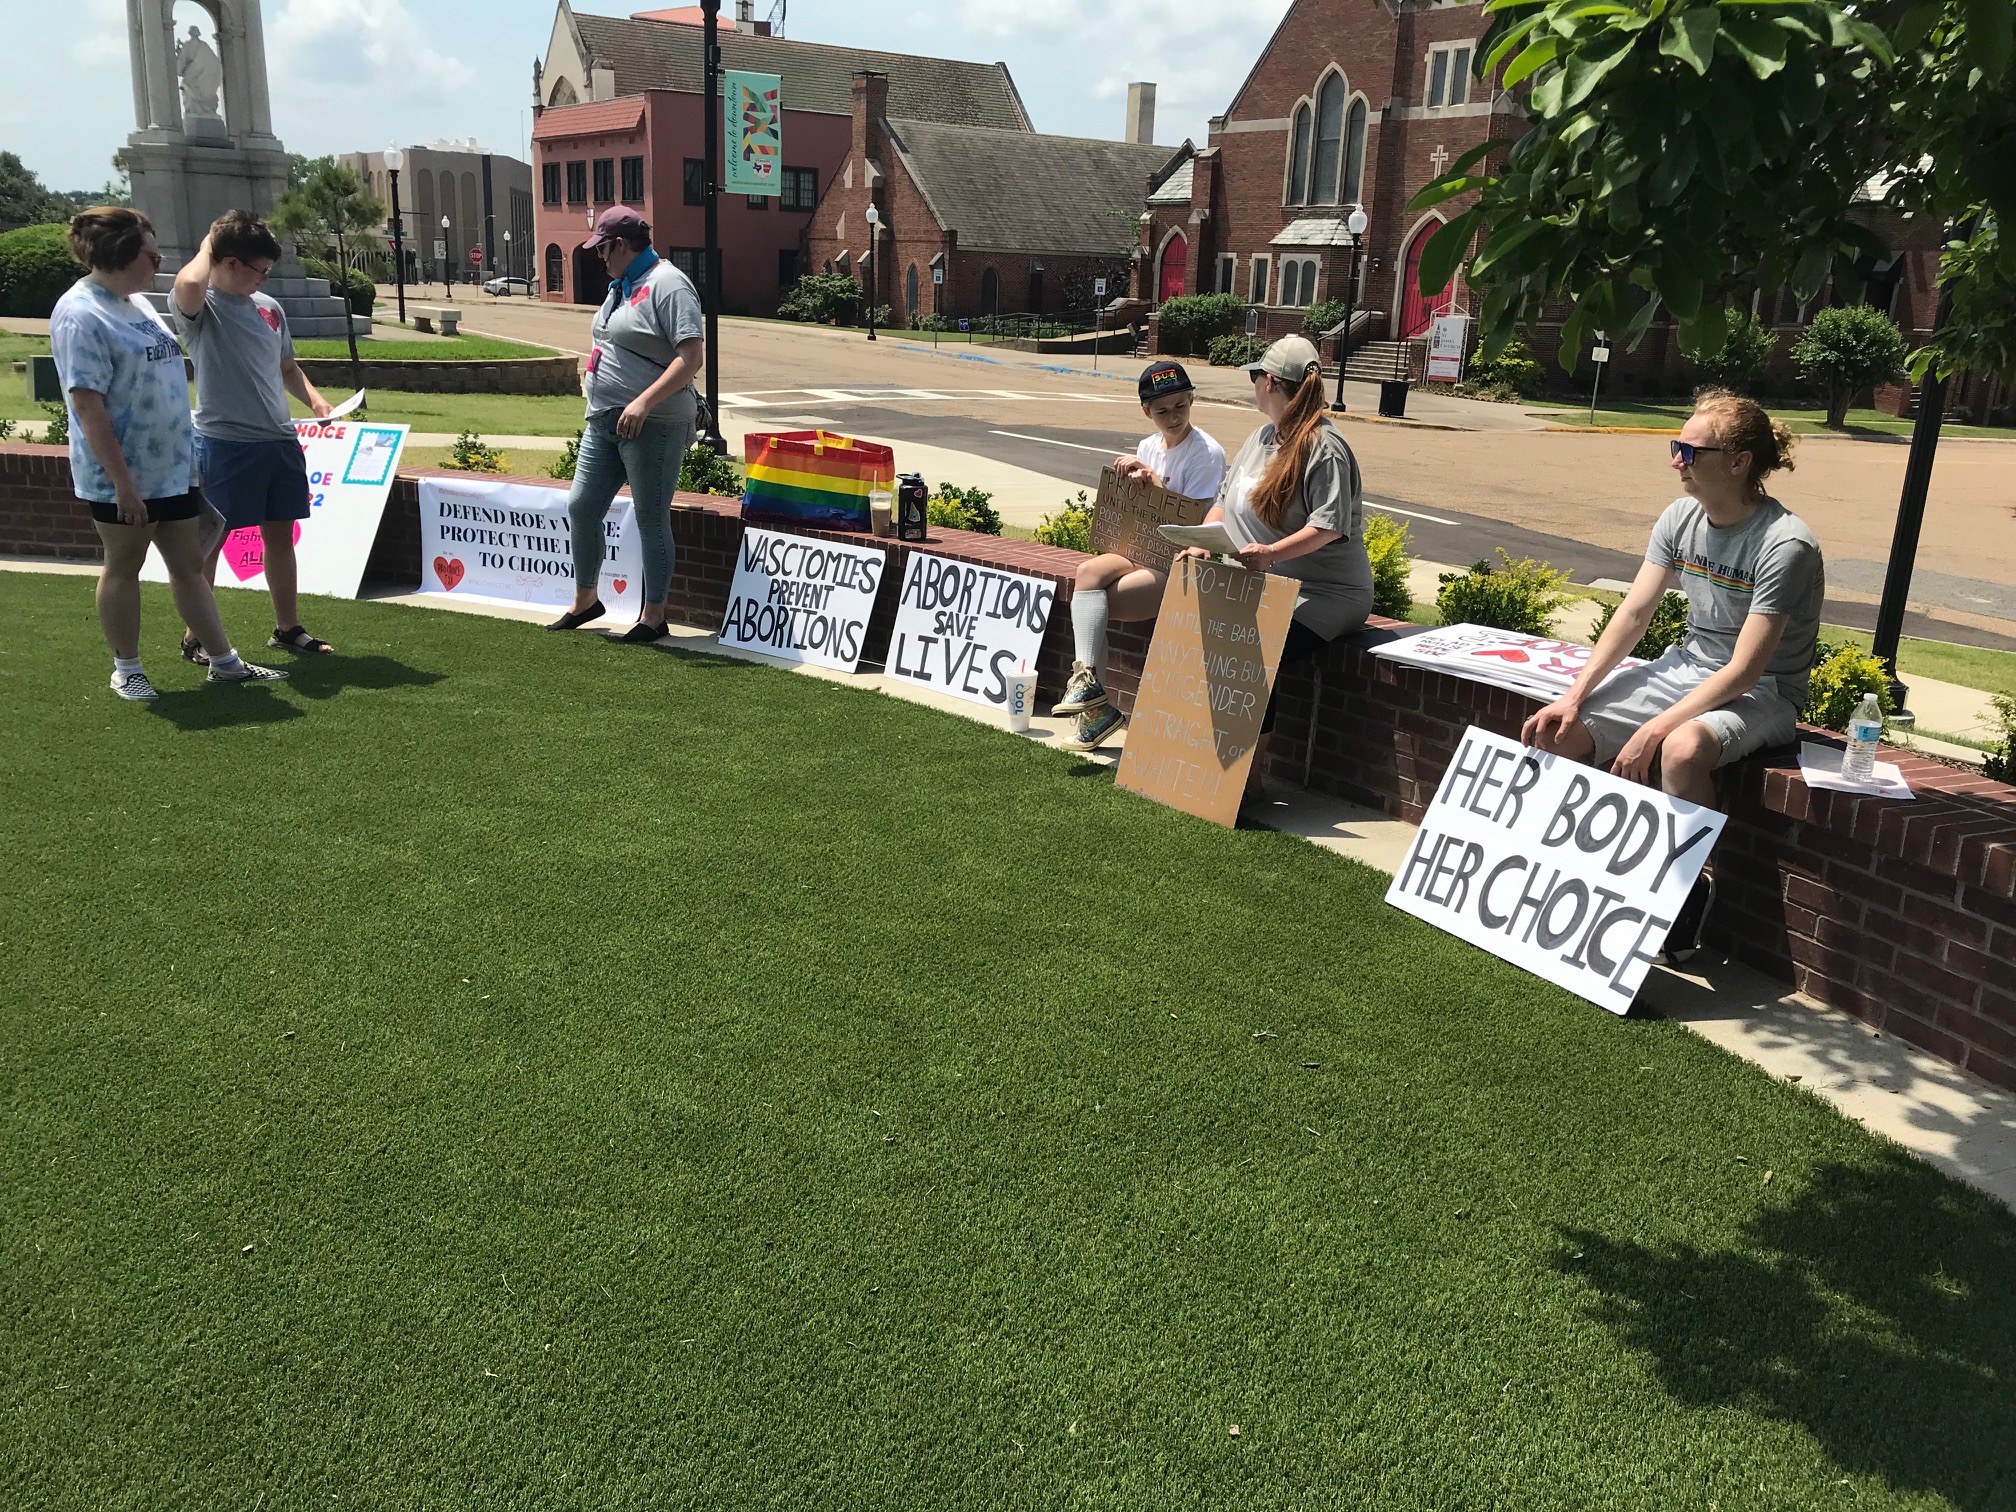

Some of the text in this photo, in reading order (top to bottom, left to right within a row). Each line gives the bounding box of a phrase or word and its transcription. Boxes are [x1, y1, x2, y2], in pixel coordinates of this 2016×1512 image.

[727, 82, 738, 178] welcome to downtown
[296, 424, 347, 440] HOICE
[439, 501, 506, 525] DEFEND
[509, 510, 546, 530] ROE
[549, 519, 558, 531] v
[1103, 493, 1129, 513] UNTIL
[1132, 504, 1148, 519] THE
[439, 524, 520, 549] PROTECT
[523, 535, 561, 554] THE
[1093, 536, 1172, 570] OR AN IMMIGRAN
[479, 551, 504, 569] TO
[743, 532, 883, 595] VASCTOMIES
[767, 578, 835, 611] PREVENT
[900, 555, 1054, 635] ABORTIONS
[720, 595, 864, 663] ABORTIONS
[933, 610, 978, 641] SAVE
[1165, 608, 1202, 634] UNTIL
[1207, 618, 1224, 639] THE
[1230, 624, 1263, 646] BABY
[894, 632, 1017, 704] LIVES
[1153, 638, 1276, 687] ANYTHING BUT
[1014, 683, 1025, 715] COOL
[1151, 669, 1256, 721] CISGENDER
[1440, 738, 1714, 894] HER BODY
[1398, 828, 1672, 999] HER CHOICE
